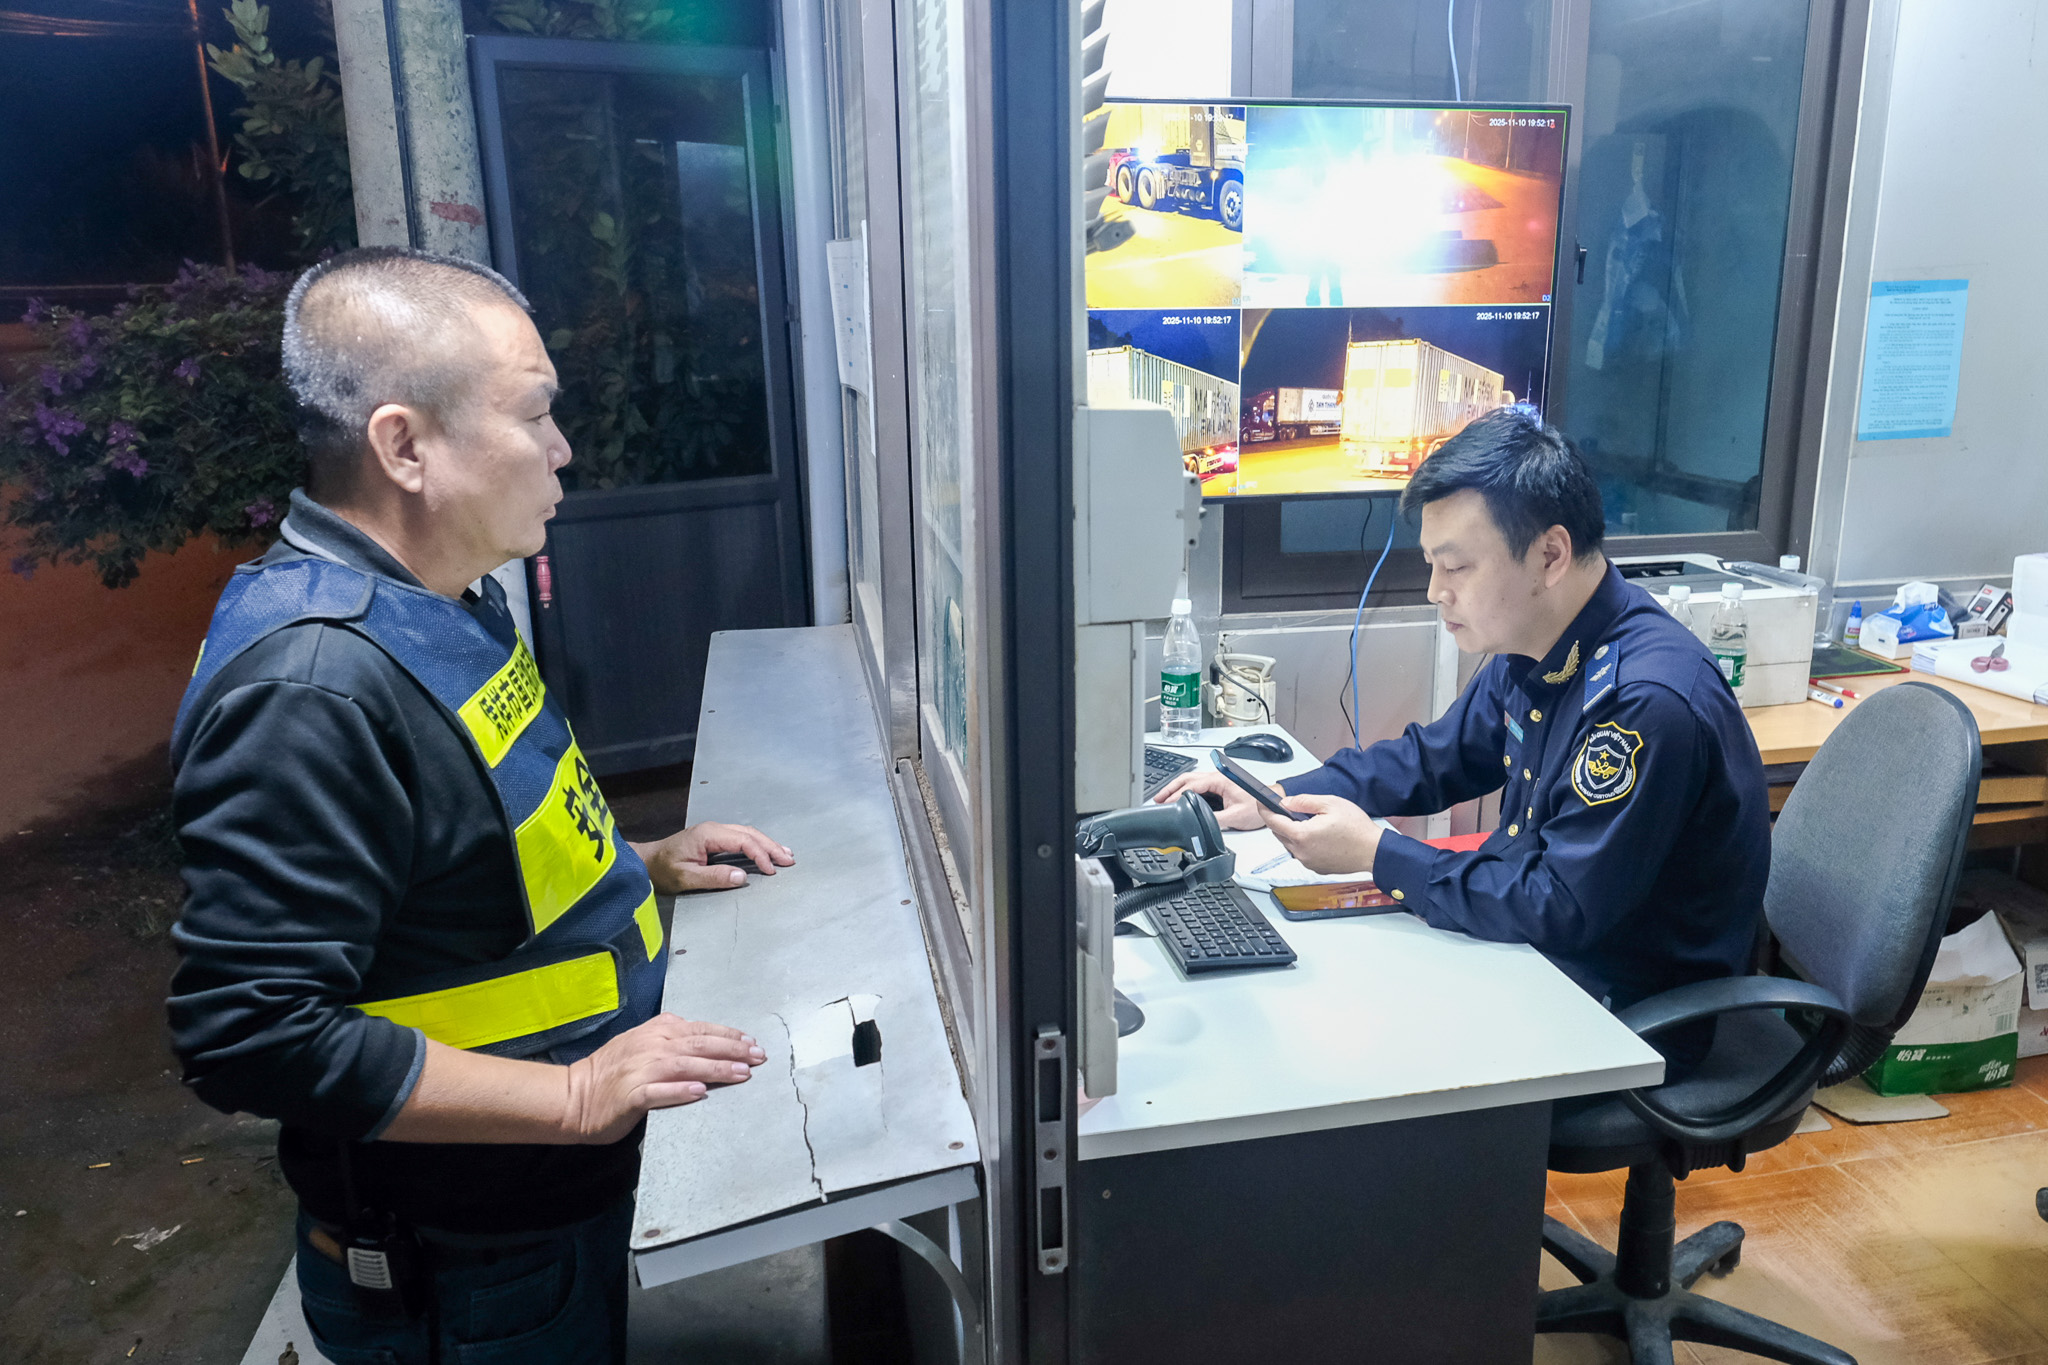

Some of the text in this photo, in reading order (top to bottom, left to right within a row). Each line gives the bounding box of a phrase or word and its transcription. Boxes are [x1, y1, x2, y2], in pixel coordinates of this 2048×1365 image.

[1489, 118, 1526, 126] 2025-11-10
[1162, 316, 1232, 324] 2025-11-10 19:52:17
[1476, 312, 1539, 320] 2025-11-10 19:52:17
